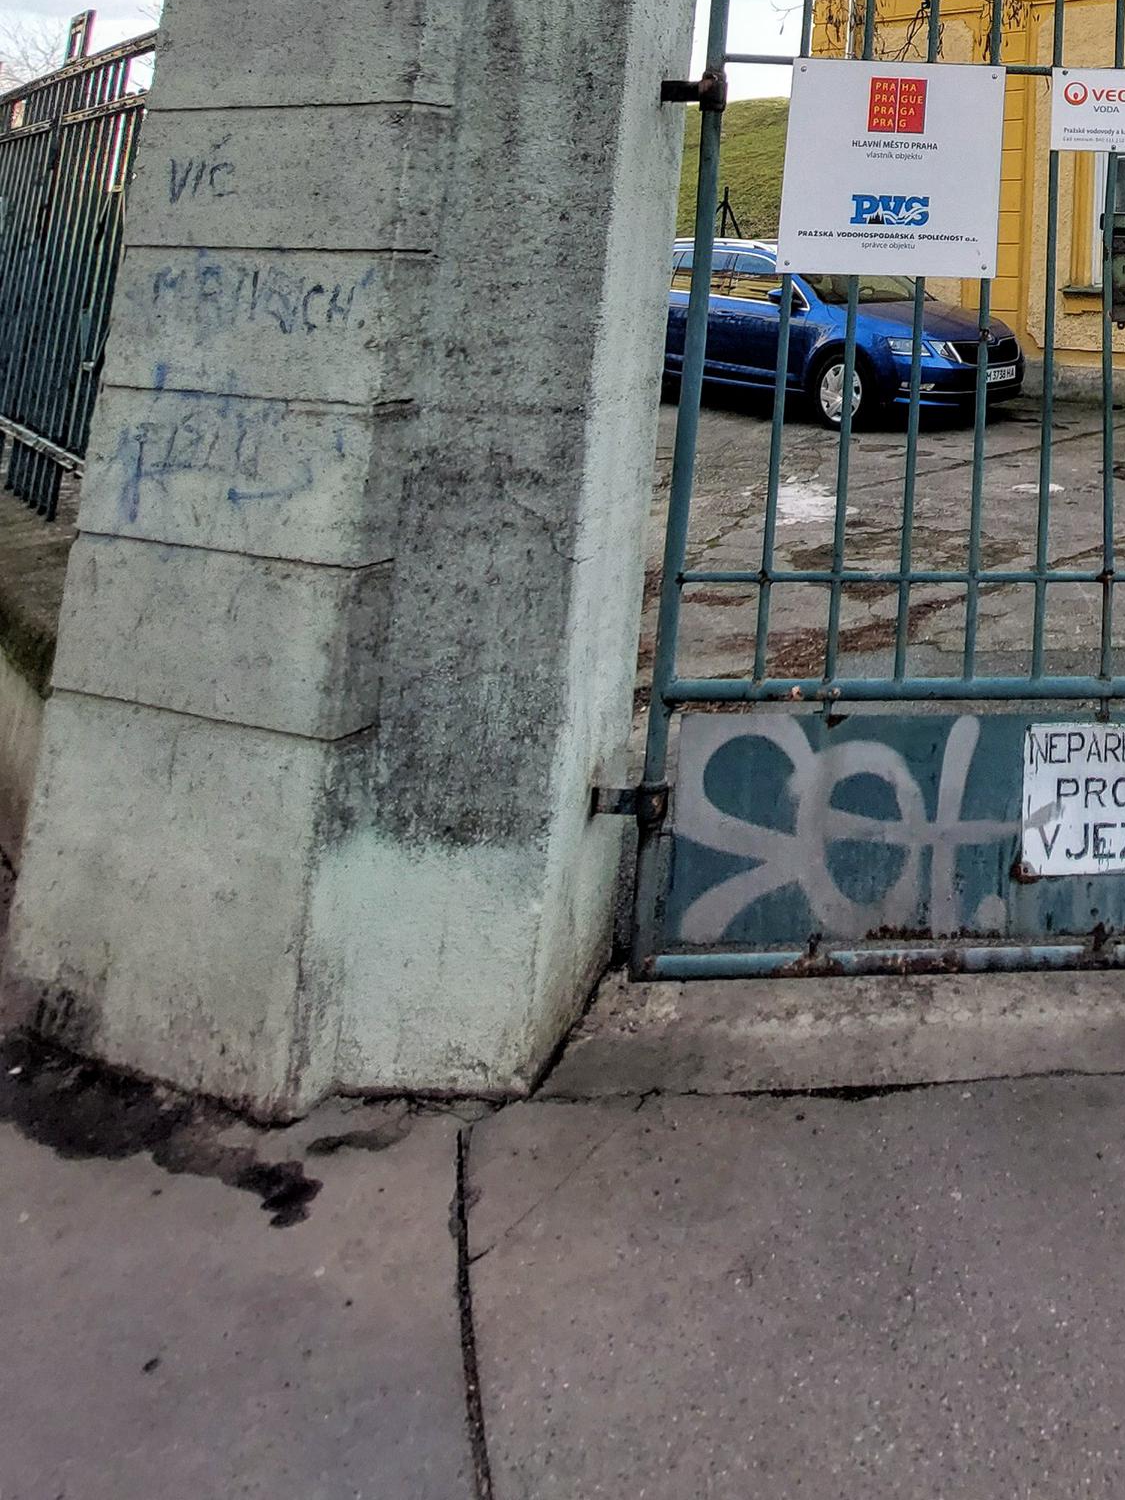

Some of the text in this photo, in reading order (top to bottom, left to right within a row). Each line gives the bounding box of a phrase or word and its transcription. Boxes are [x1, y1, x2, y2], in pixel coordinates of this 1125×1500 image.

[1093, 105, 1120, 113] VODA
[1087, 127, 1114, 136] vodovody
[851, 139, 938, 150] HLAVNÍ MĚSTO PRAHA
[866, 150, 923, 161] vlastník objektu
[850, 194, 930, 226] PVS
[889, 241, 915, 250] objektu
